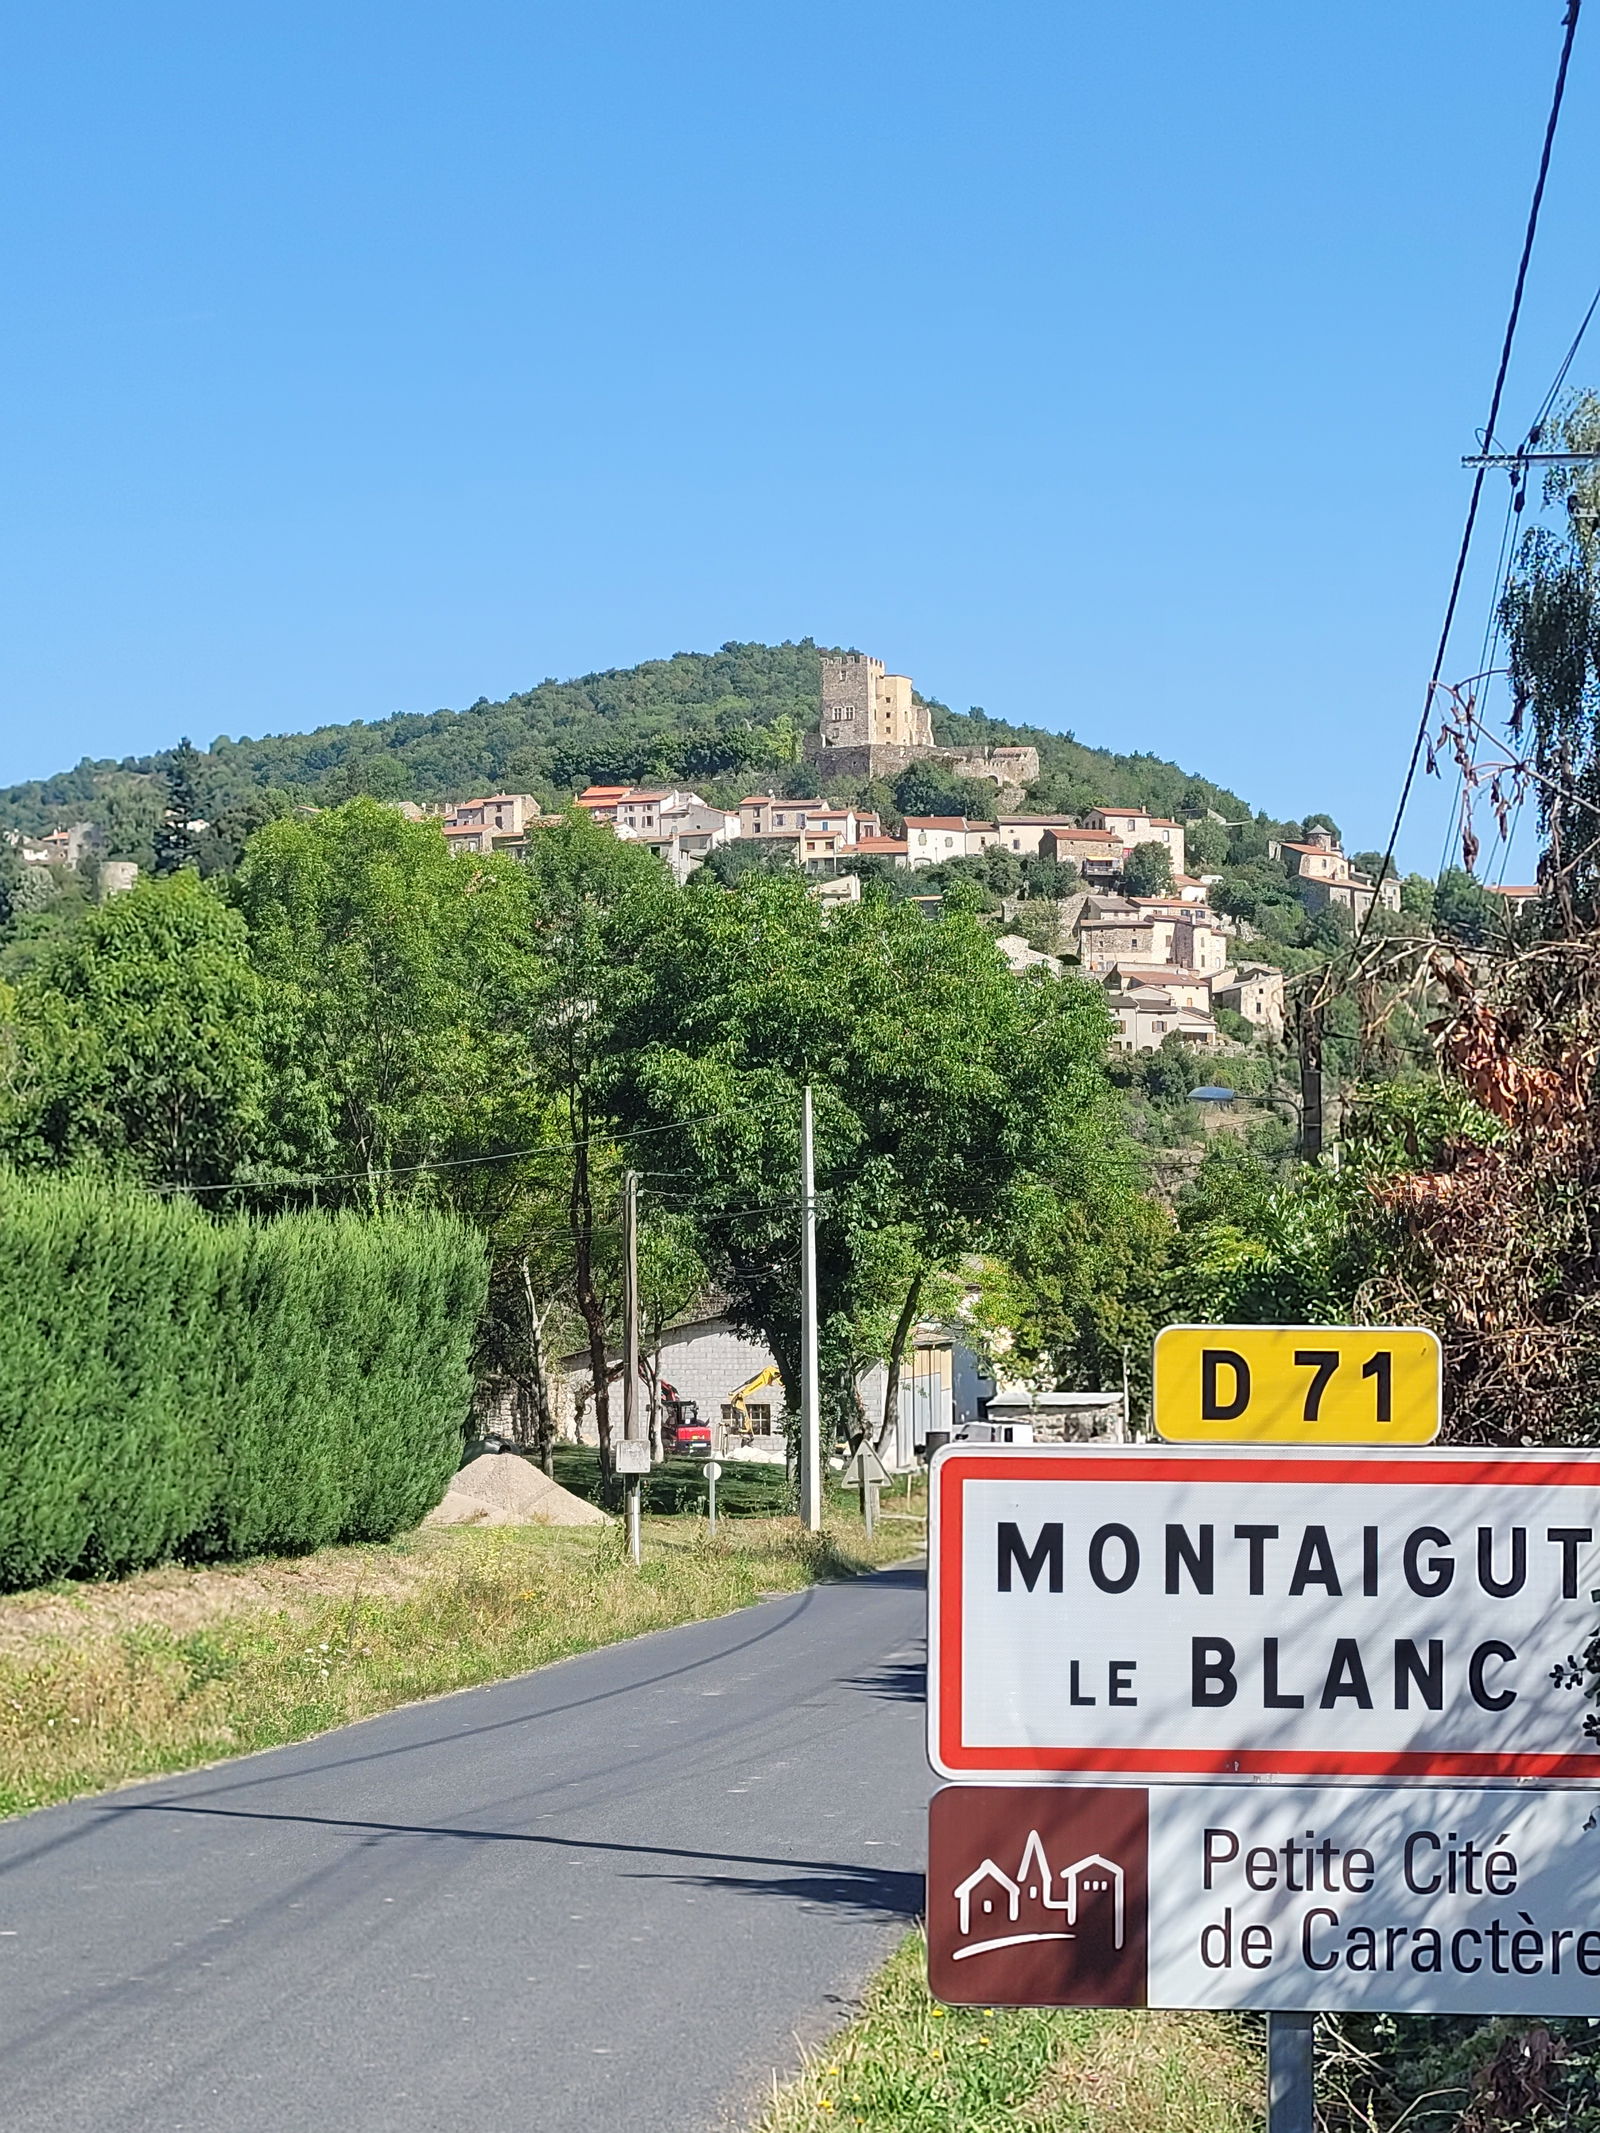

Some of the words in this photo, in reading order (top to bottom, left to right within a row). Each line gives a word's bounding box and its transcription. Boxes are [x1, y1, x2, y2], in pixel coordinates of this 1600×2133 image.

[1202, 1349, 1251, 1421] D
[1294, 1350, 1391, 1422] 71
[997, 1522, 1593, 1599] MONTAIGUT
[1070, 1660, 1138, 1707] LE
[1191, 1636, 1517, 1712] BLANC
[1203, 1828, 1375, 1893] Petite
[1404, 1830, 1517, 1896] Cité
[1201, 1907, 1272, 1969] de
[1302, 1907, 1600, 1977] Caractère
